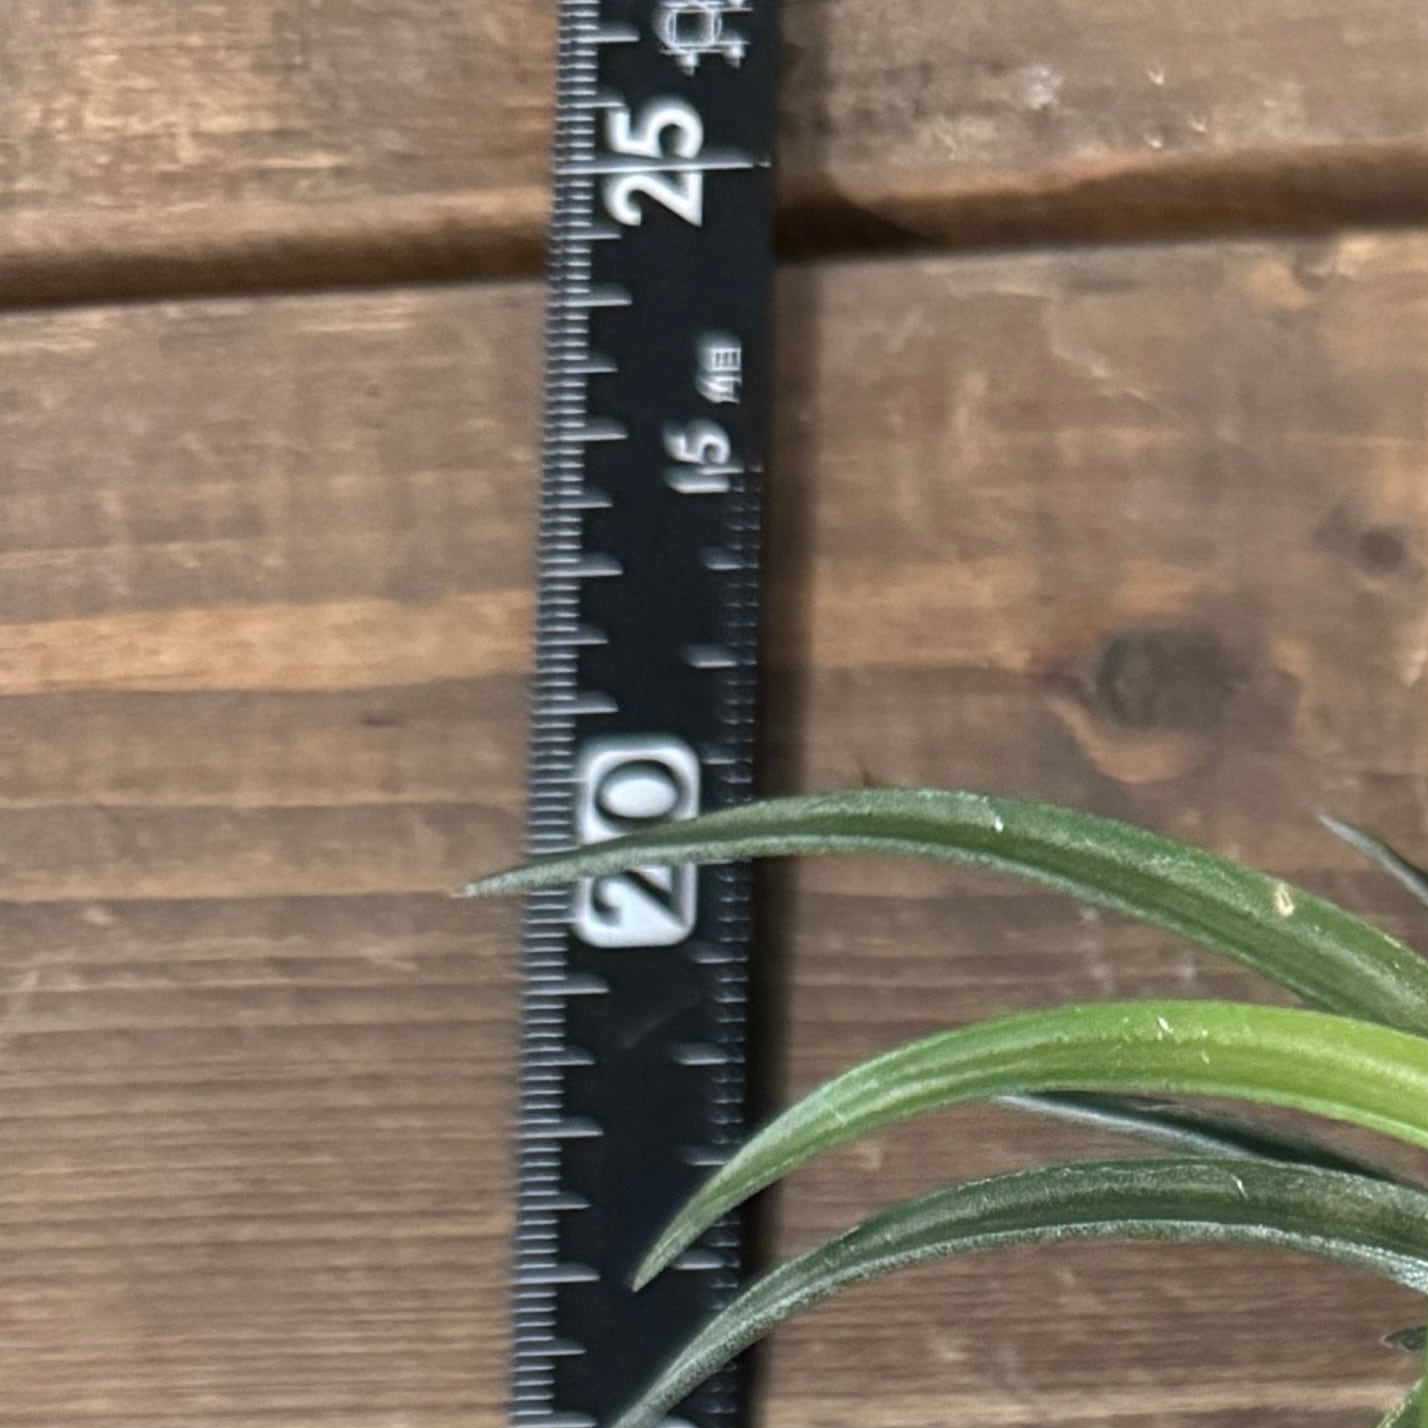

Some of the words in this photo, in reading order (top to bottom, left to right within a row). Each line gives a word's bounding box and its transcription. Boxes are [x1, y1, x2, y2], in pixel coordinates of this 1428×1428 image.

[604, 97, 704, 227] 25
[665, 418, 731, 494] 15
[590, 759, 687, 928] 20
